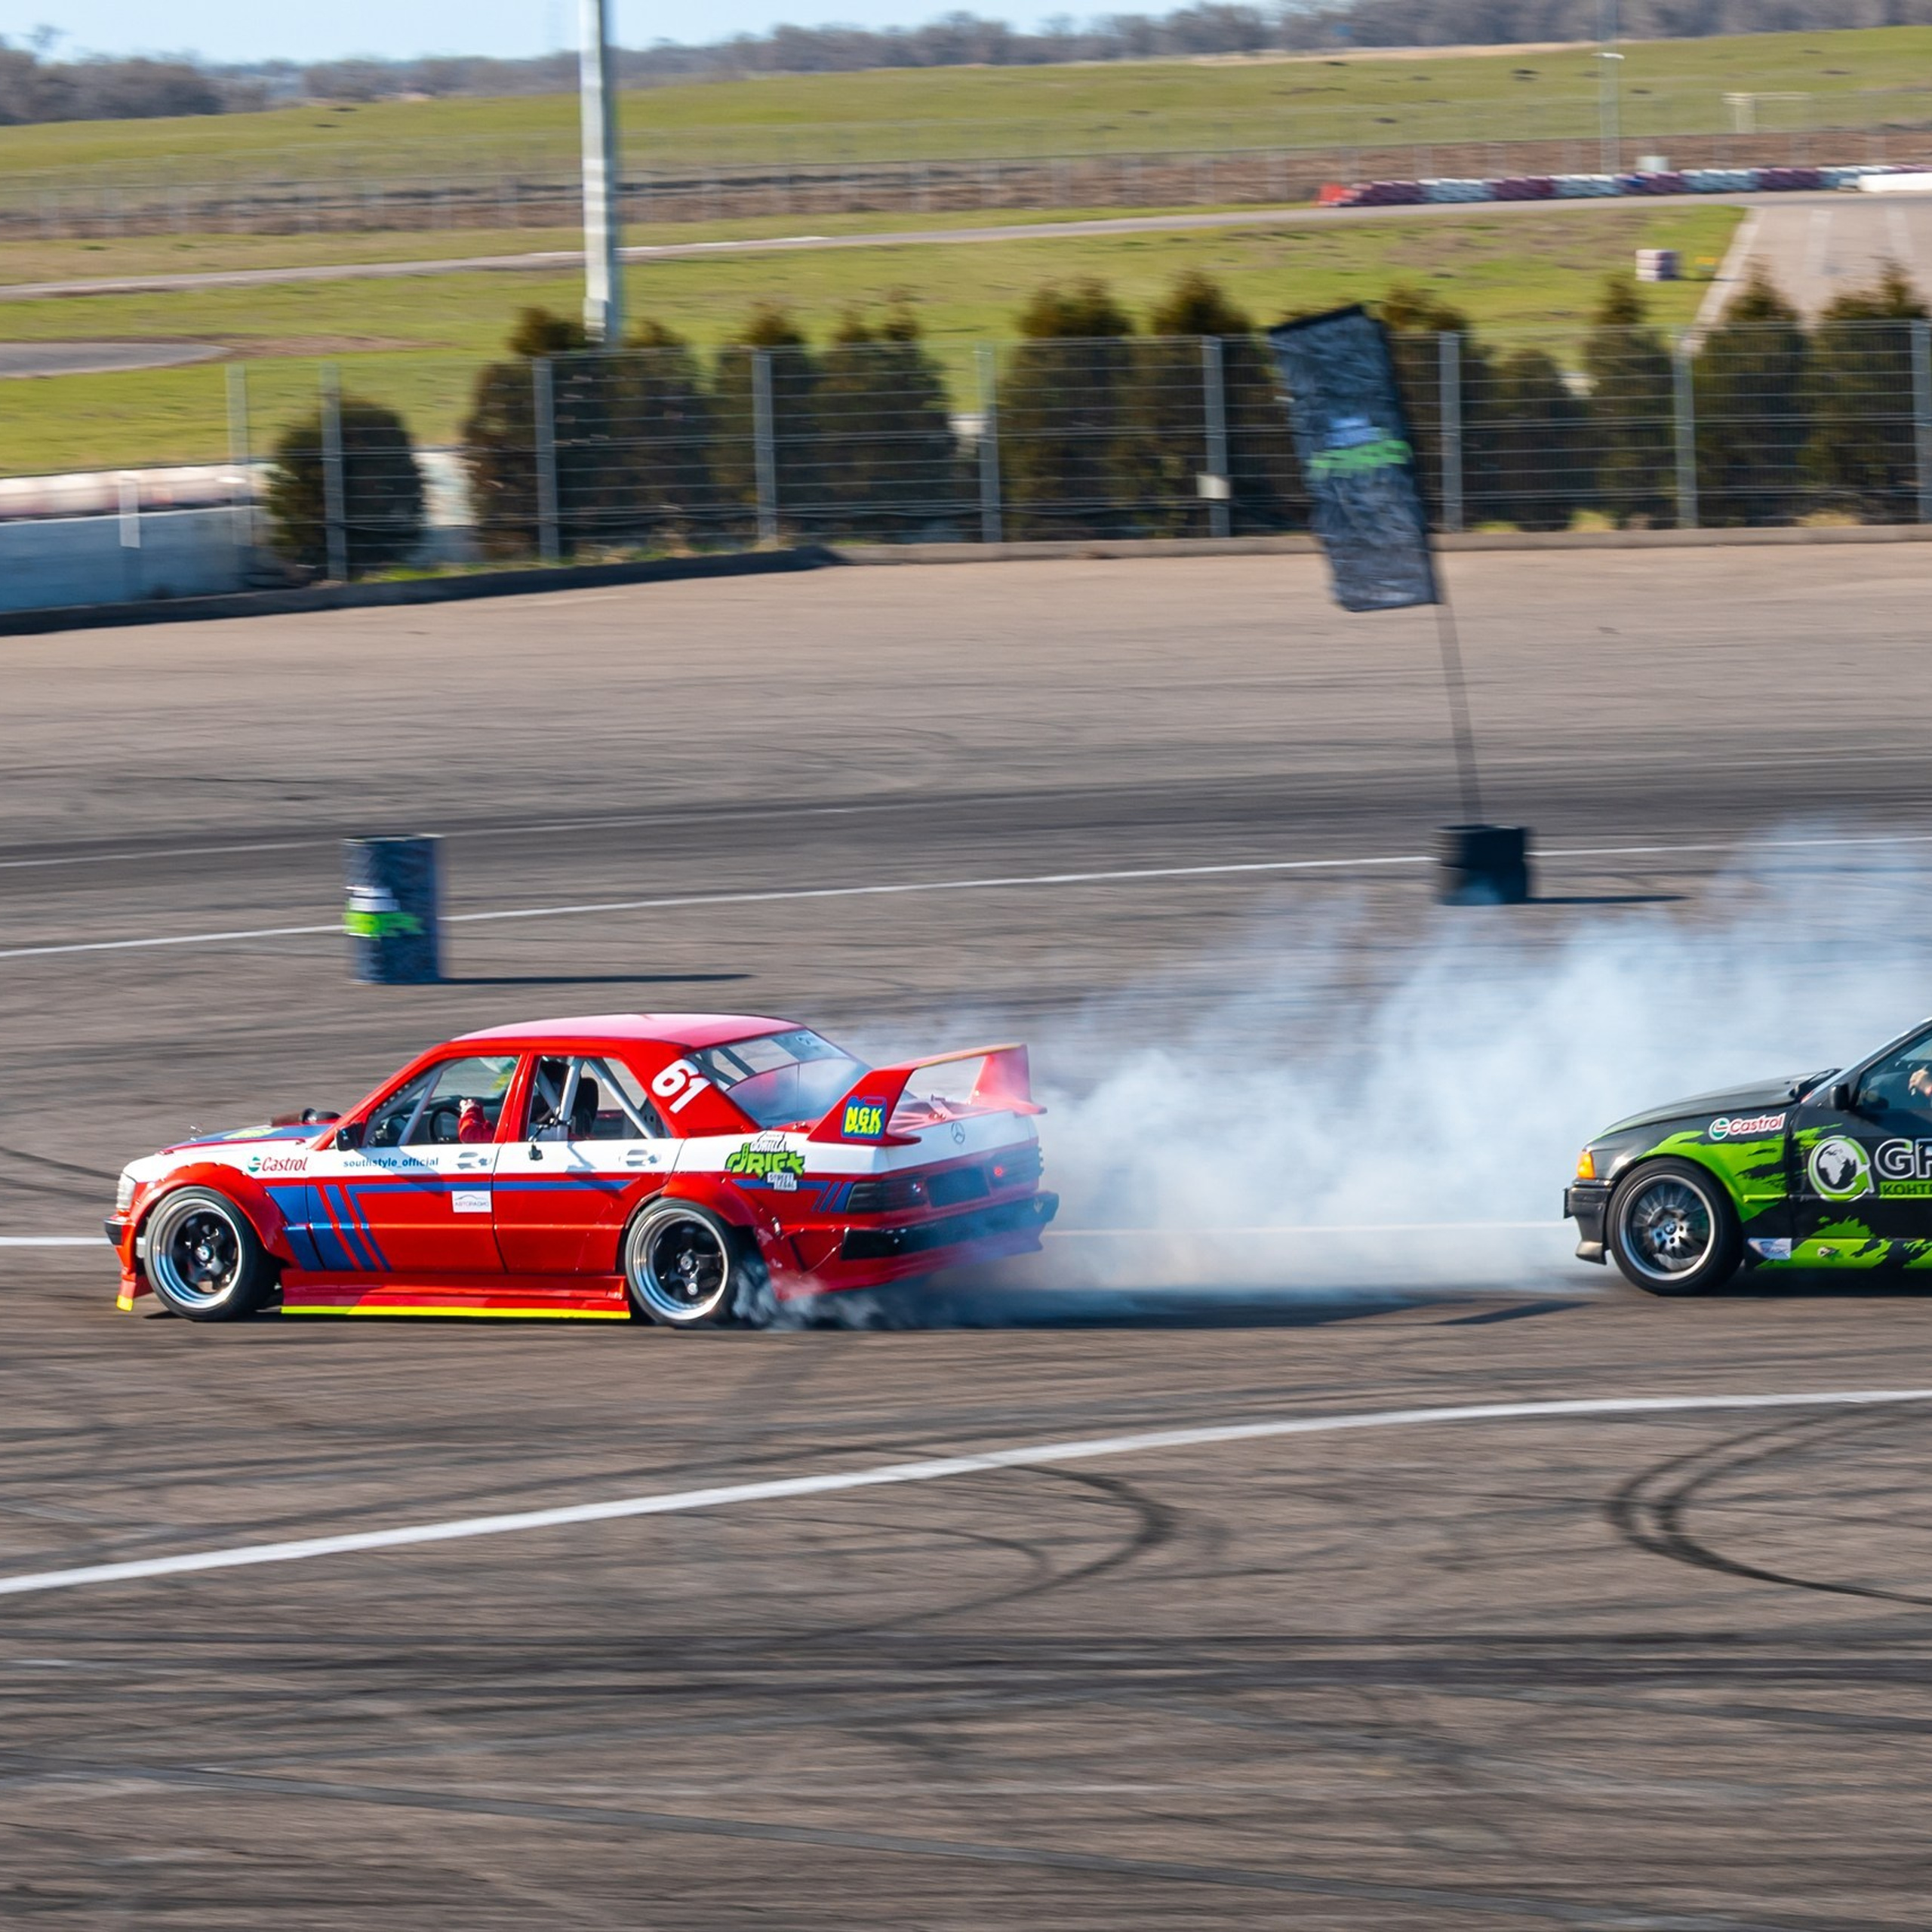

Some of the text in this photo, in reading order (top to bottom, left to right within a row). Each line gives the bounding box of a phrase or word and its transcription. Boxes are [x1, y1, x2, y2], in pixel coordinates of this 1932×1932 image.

[651, 1059, 712, 1114] 61
[844, 1106, 882, 1128] NGK
[1730, 1114, 1786, 1134] Castrol
[261, 1156, 309, 1172] Castrol
[343, 1157, 439, 1168] southstyle_official
[1882, 1183, 1932, 1195] КОНТ
